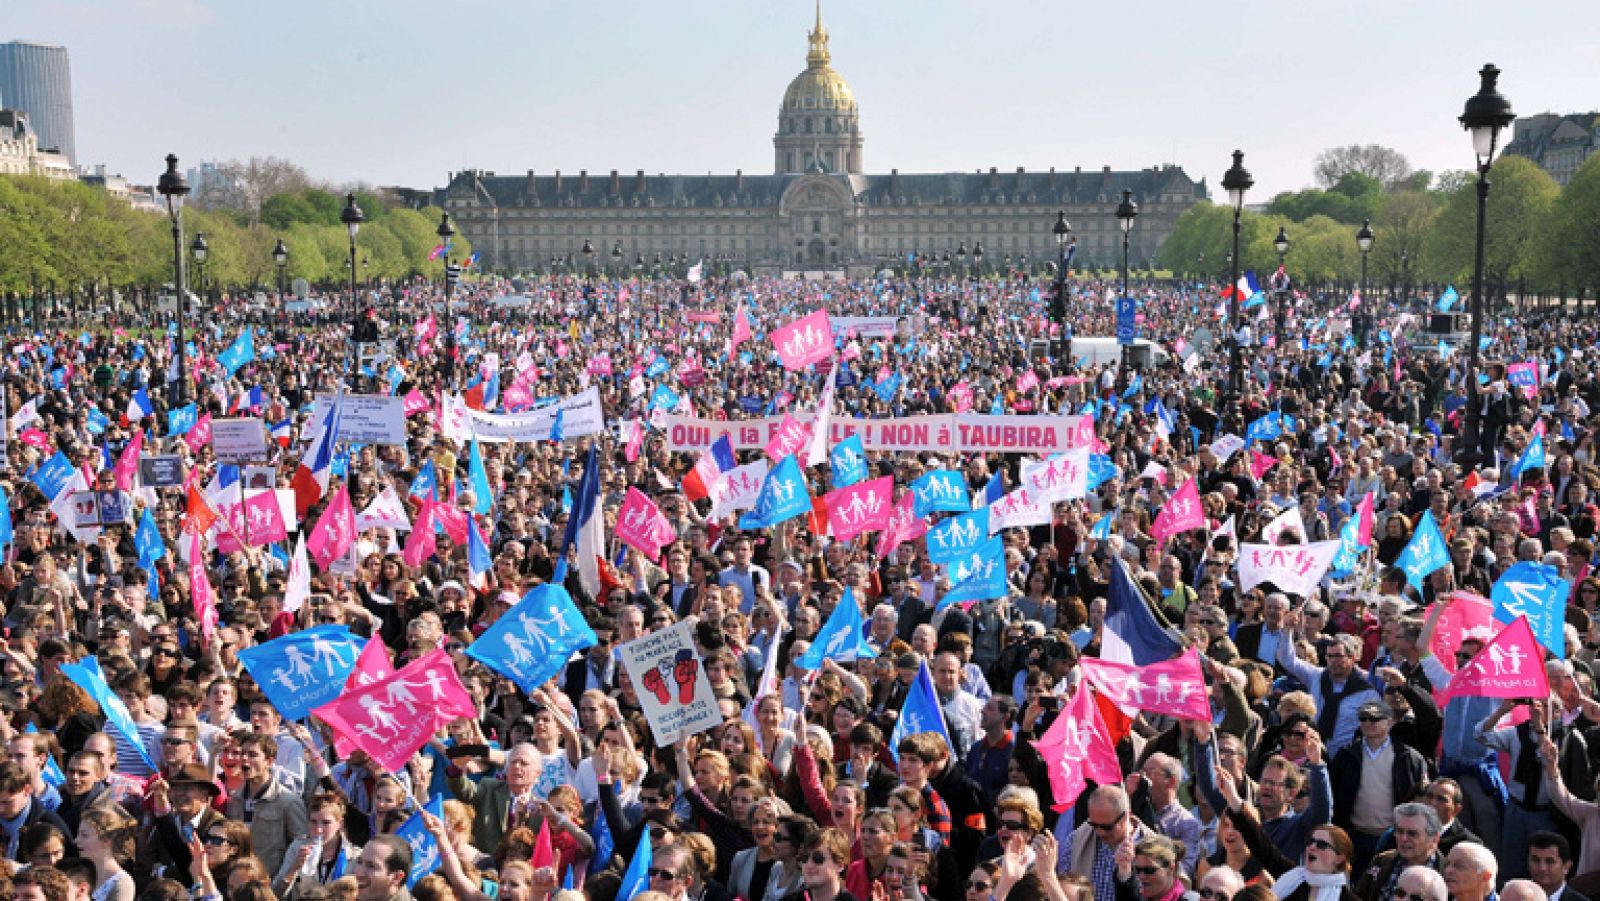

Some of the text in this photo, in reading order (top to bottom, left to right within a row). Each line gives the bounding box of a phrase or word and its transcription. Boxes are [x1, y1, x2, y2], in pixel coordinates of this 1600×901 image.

[1122, 301, 1130, 313] P
[672, 424, 710, 446] OUI
[741, 426, 759, 443] la
[880, 424, 929, 445] NON
[937, 424, 950, 445] à
[958, 424, 1057, 447] TAUBIRA
